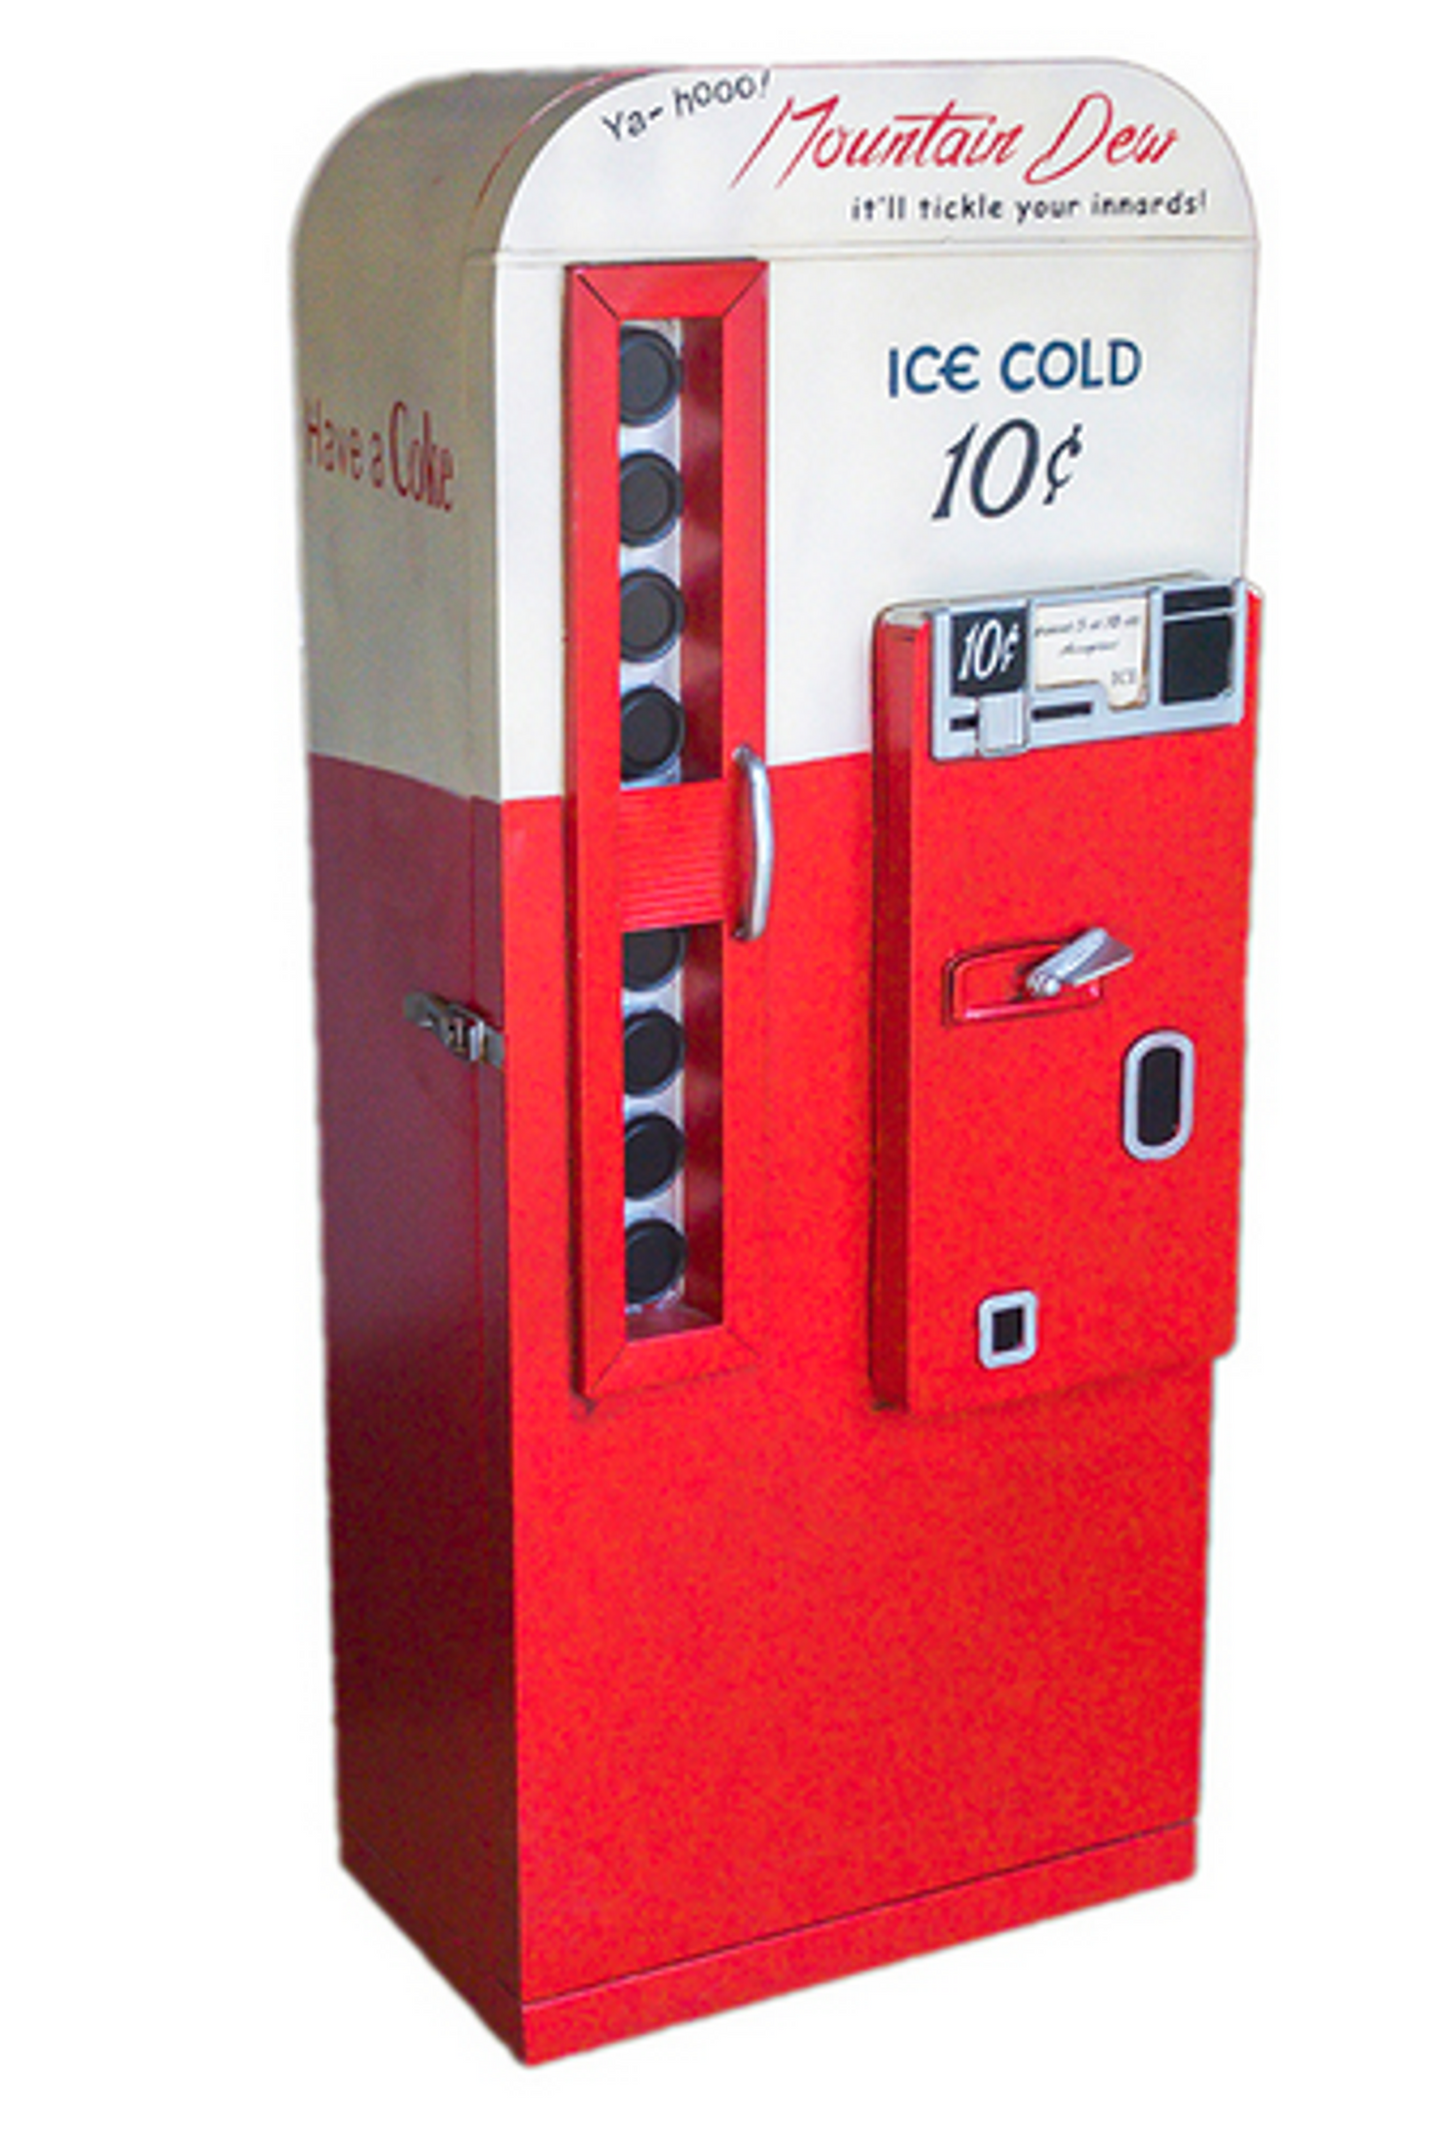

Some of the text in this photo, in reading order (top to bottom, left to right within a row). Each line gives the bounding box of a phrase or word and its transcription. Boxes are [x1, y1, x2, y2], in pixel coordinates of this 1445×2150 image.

[730, 92, 1178, 190] Mountain Dew
[919, 196, 1003, 219] tickle
[1016, 197, 1079, 223] your
[1091, 189, 1206, 215] innards!
[888, 338, 1142, 398] ICE COLD
[304, 398, 454, 513] Have a Coke
[932, 418, 1082, 520] 10¢
[957, 619, 1019, 681] 10¢
